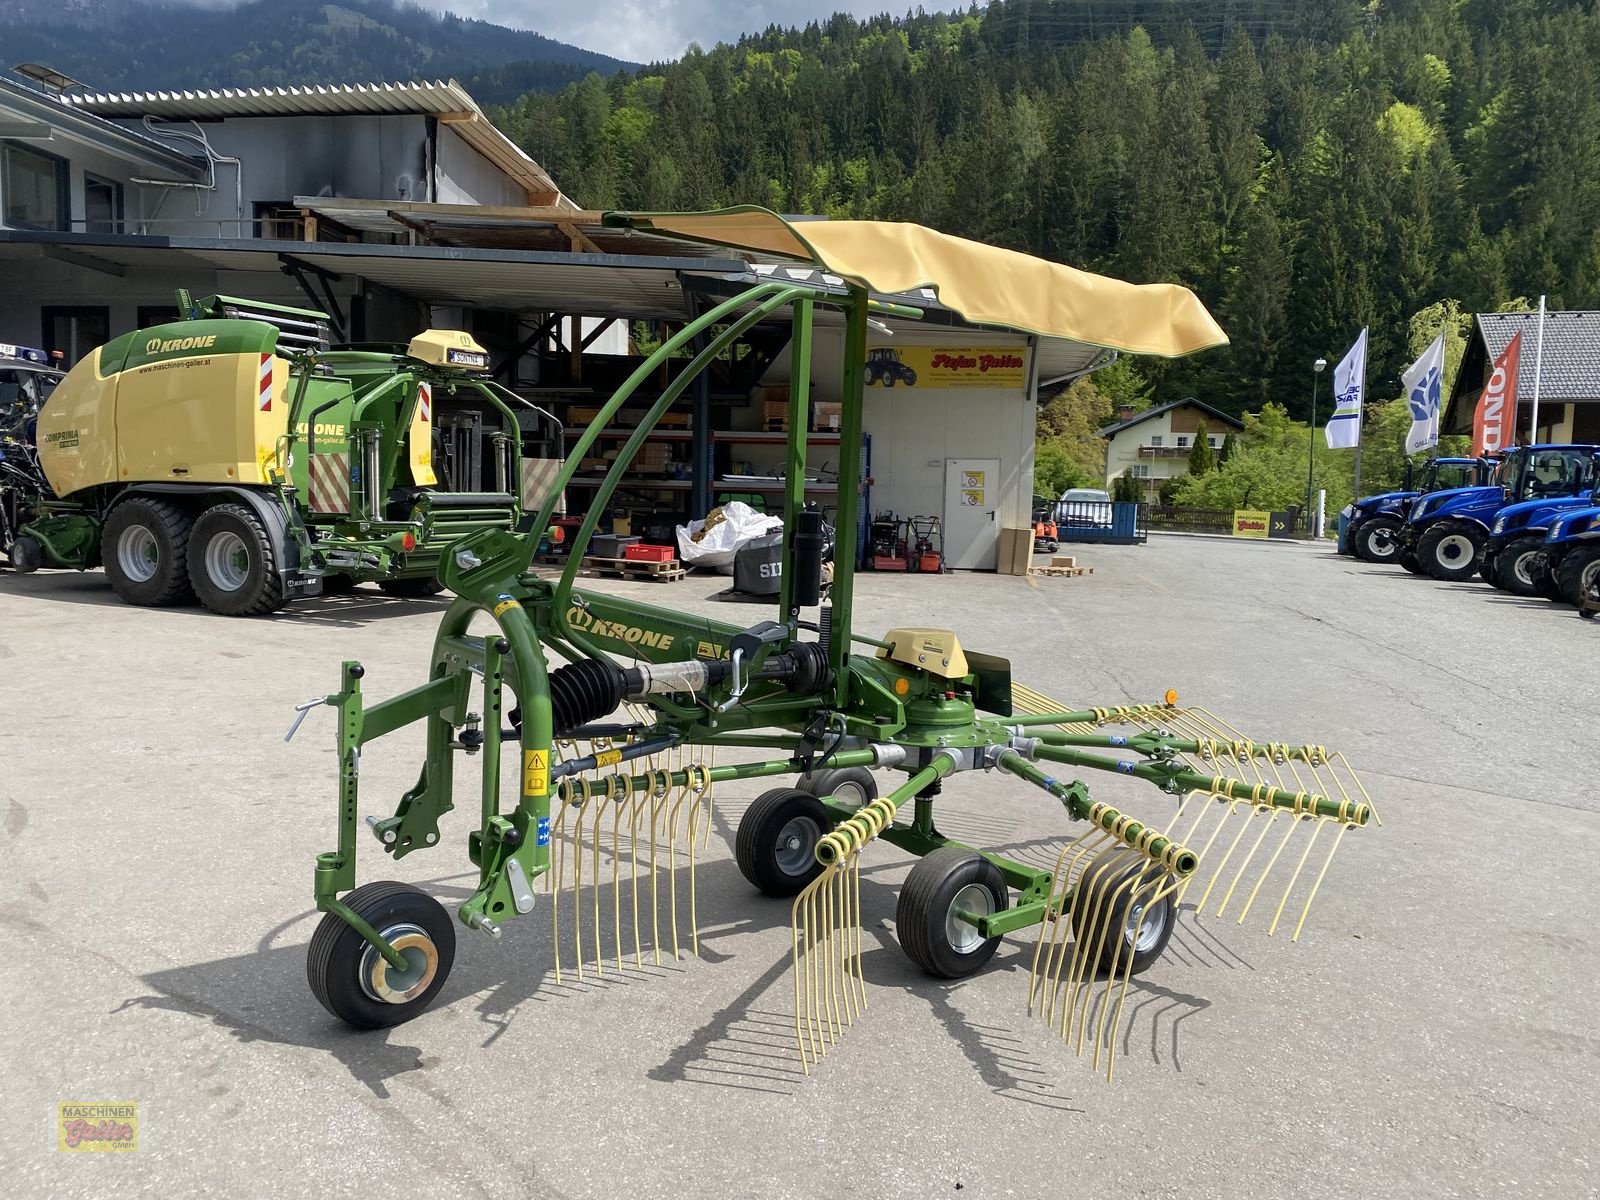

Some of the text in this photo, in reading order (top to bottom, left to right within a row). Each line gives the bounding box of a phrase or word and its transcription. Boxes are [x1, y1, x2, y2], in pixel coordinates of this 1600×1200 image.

[160, 335, 217, 353] KRONE
[138, 358, 211, 374] www.maschinen-gailer.at
[931, 354, 977, 371] Stefan
[590, 619, 675, 651] KRONE
